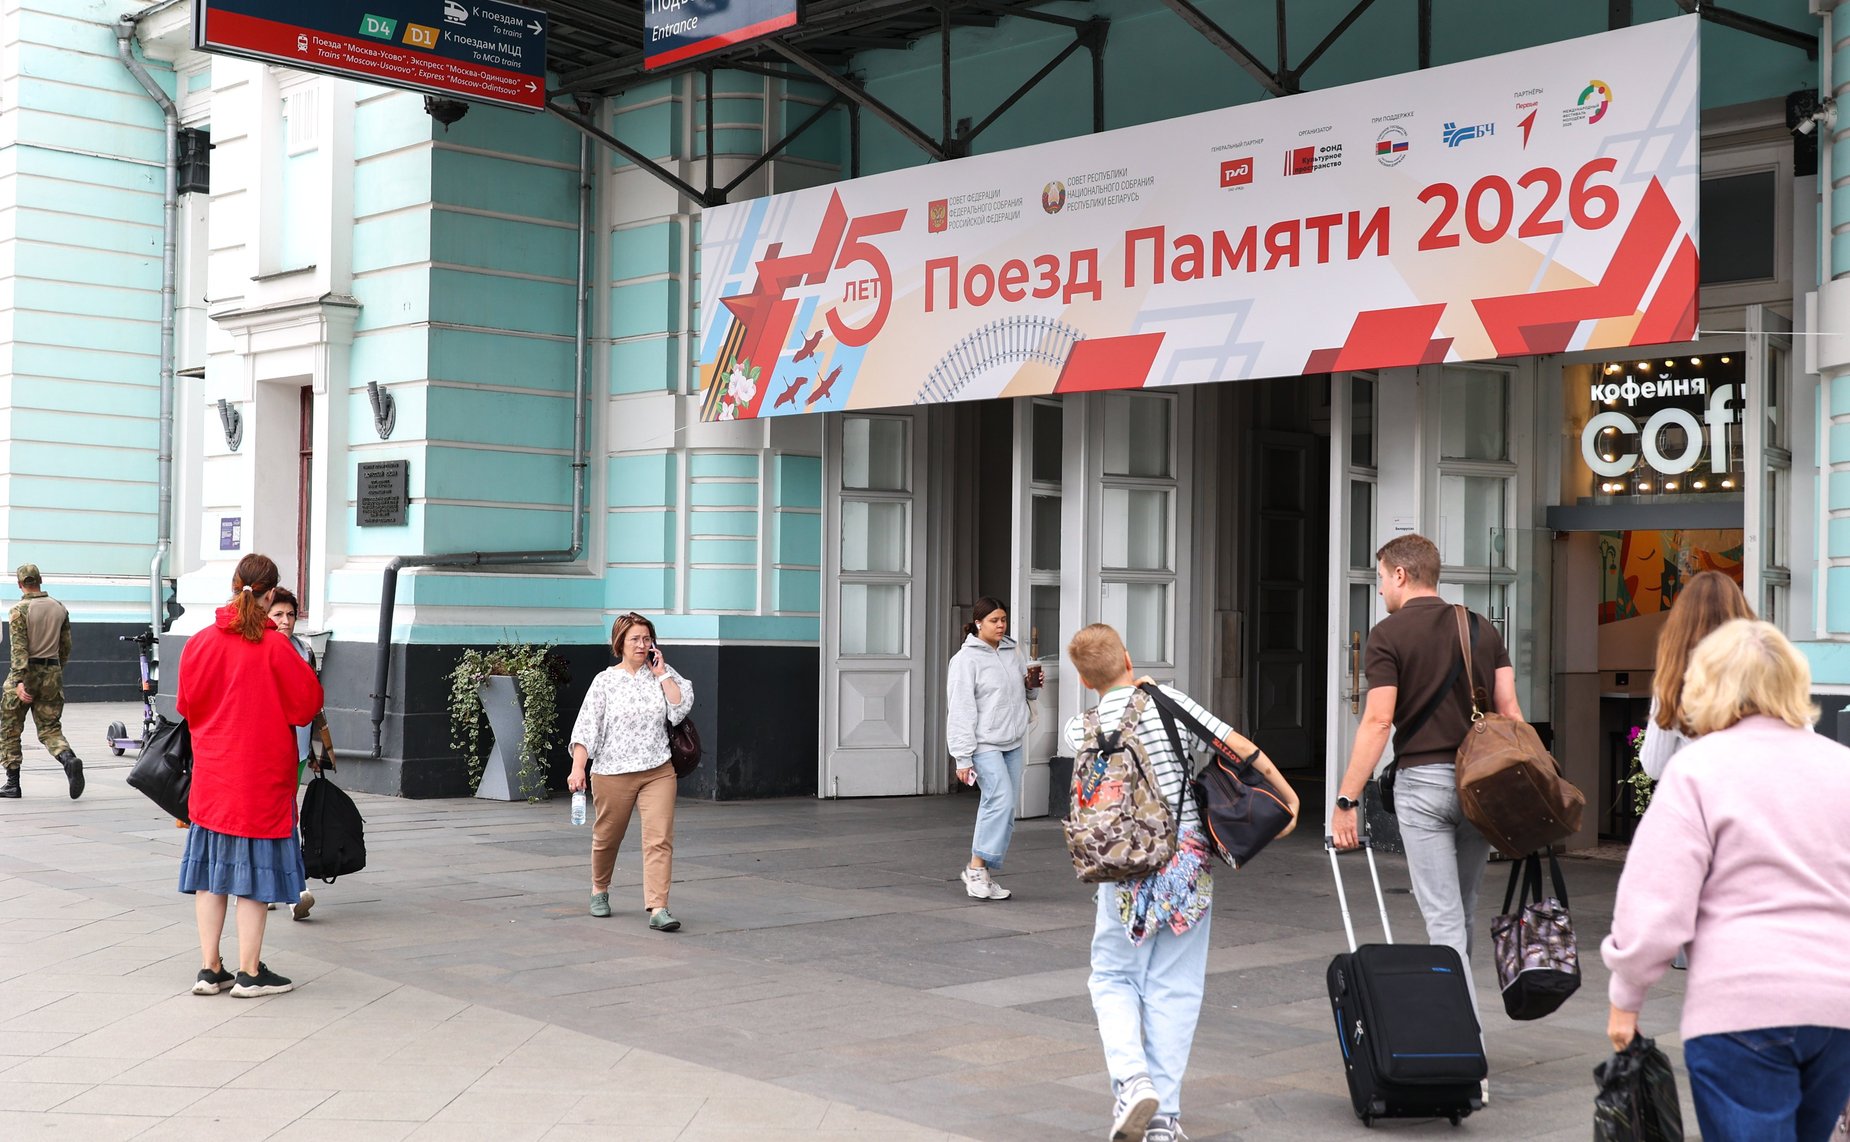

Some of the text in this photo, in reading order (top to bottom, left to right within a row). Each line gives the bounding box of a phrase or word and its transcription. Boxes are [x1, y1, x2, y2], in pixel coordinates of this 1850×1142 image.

[473, 6, 523, 27] К поездам
[367, 17, 390, 35] D4
[493, 25, 522, 38] To trains
[652, 16, 698, 41] Entrance
[411, 27, 432, 45] D1
[444, 31, 522, 58] К поездам МЦД
[312, 36, 342, 49] Поезда
[411, 56, 444, 71] Экспресс
[473, 52, 522, 68] To MCD trains
[318, 48, 340, 60] Trains
[419, 69, 445, 82] Express
[1515, 101, 1539, 110] Первые
[1371, 111, 1415, 124] ПРИ ПОДДЕРЖКЕ
[1298, 125, 1333, 137] ОРГАНИЗАТОР
[1476, 122, 1495, 138] БЧ
[1210, 141, 1243, 153] ГЕНЕРАЛЬНЫЙ
[1319, 144, 1343, 153] ФОНД
[1294, 160, 1342, 173] пространство
[1302, 152, 1342, 164] Культурное
[1067, 168, 1128, 187] СОВЕТ РЕСПУБЛИКИ
[1067, 176, 1155, 199] НАЦИОНАЛЬНОГО СОБРАНИЯ
[949, 189, 1001, 206] СОВЕТ ФЕДЕРАЦИИ
[1067, 192, 1140, 212] РЕСПУБЛИКИ БЕЛАРУСЬ
[949, 197, 1023, 218] ФЕДЕРАЛЬНОГО СОБРАНИЯ
[949, 210, 1021, 230] РОССИЙСКОЙ ФЕДЕРАЦИИ
[924, 157, 1620, 313] Поезд Памяти 2026
[842, 278, 881, 303] ЛЕТ
[1590, 373, 1705, 406] кофейня
